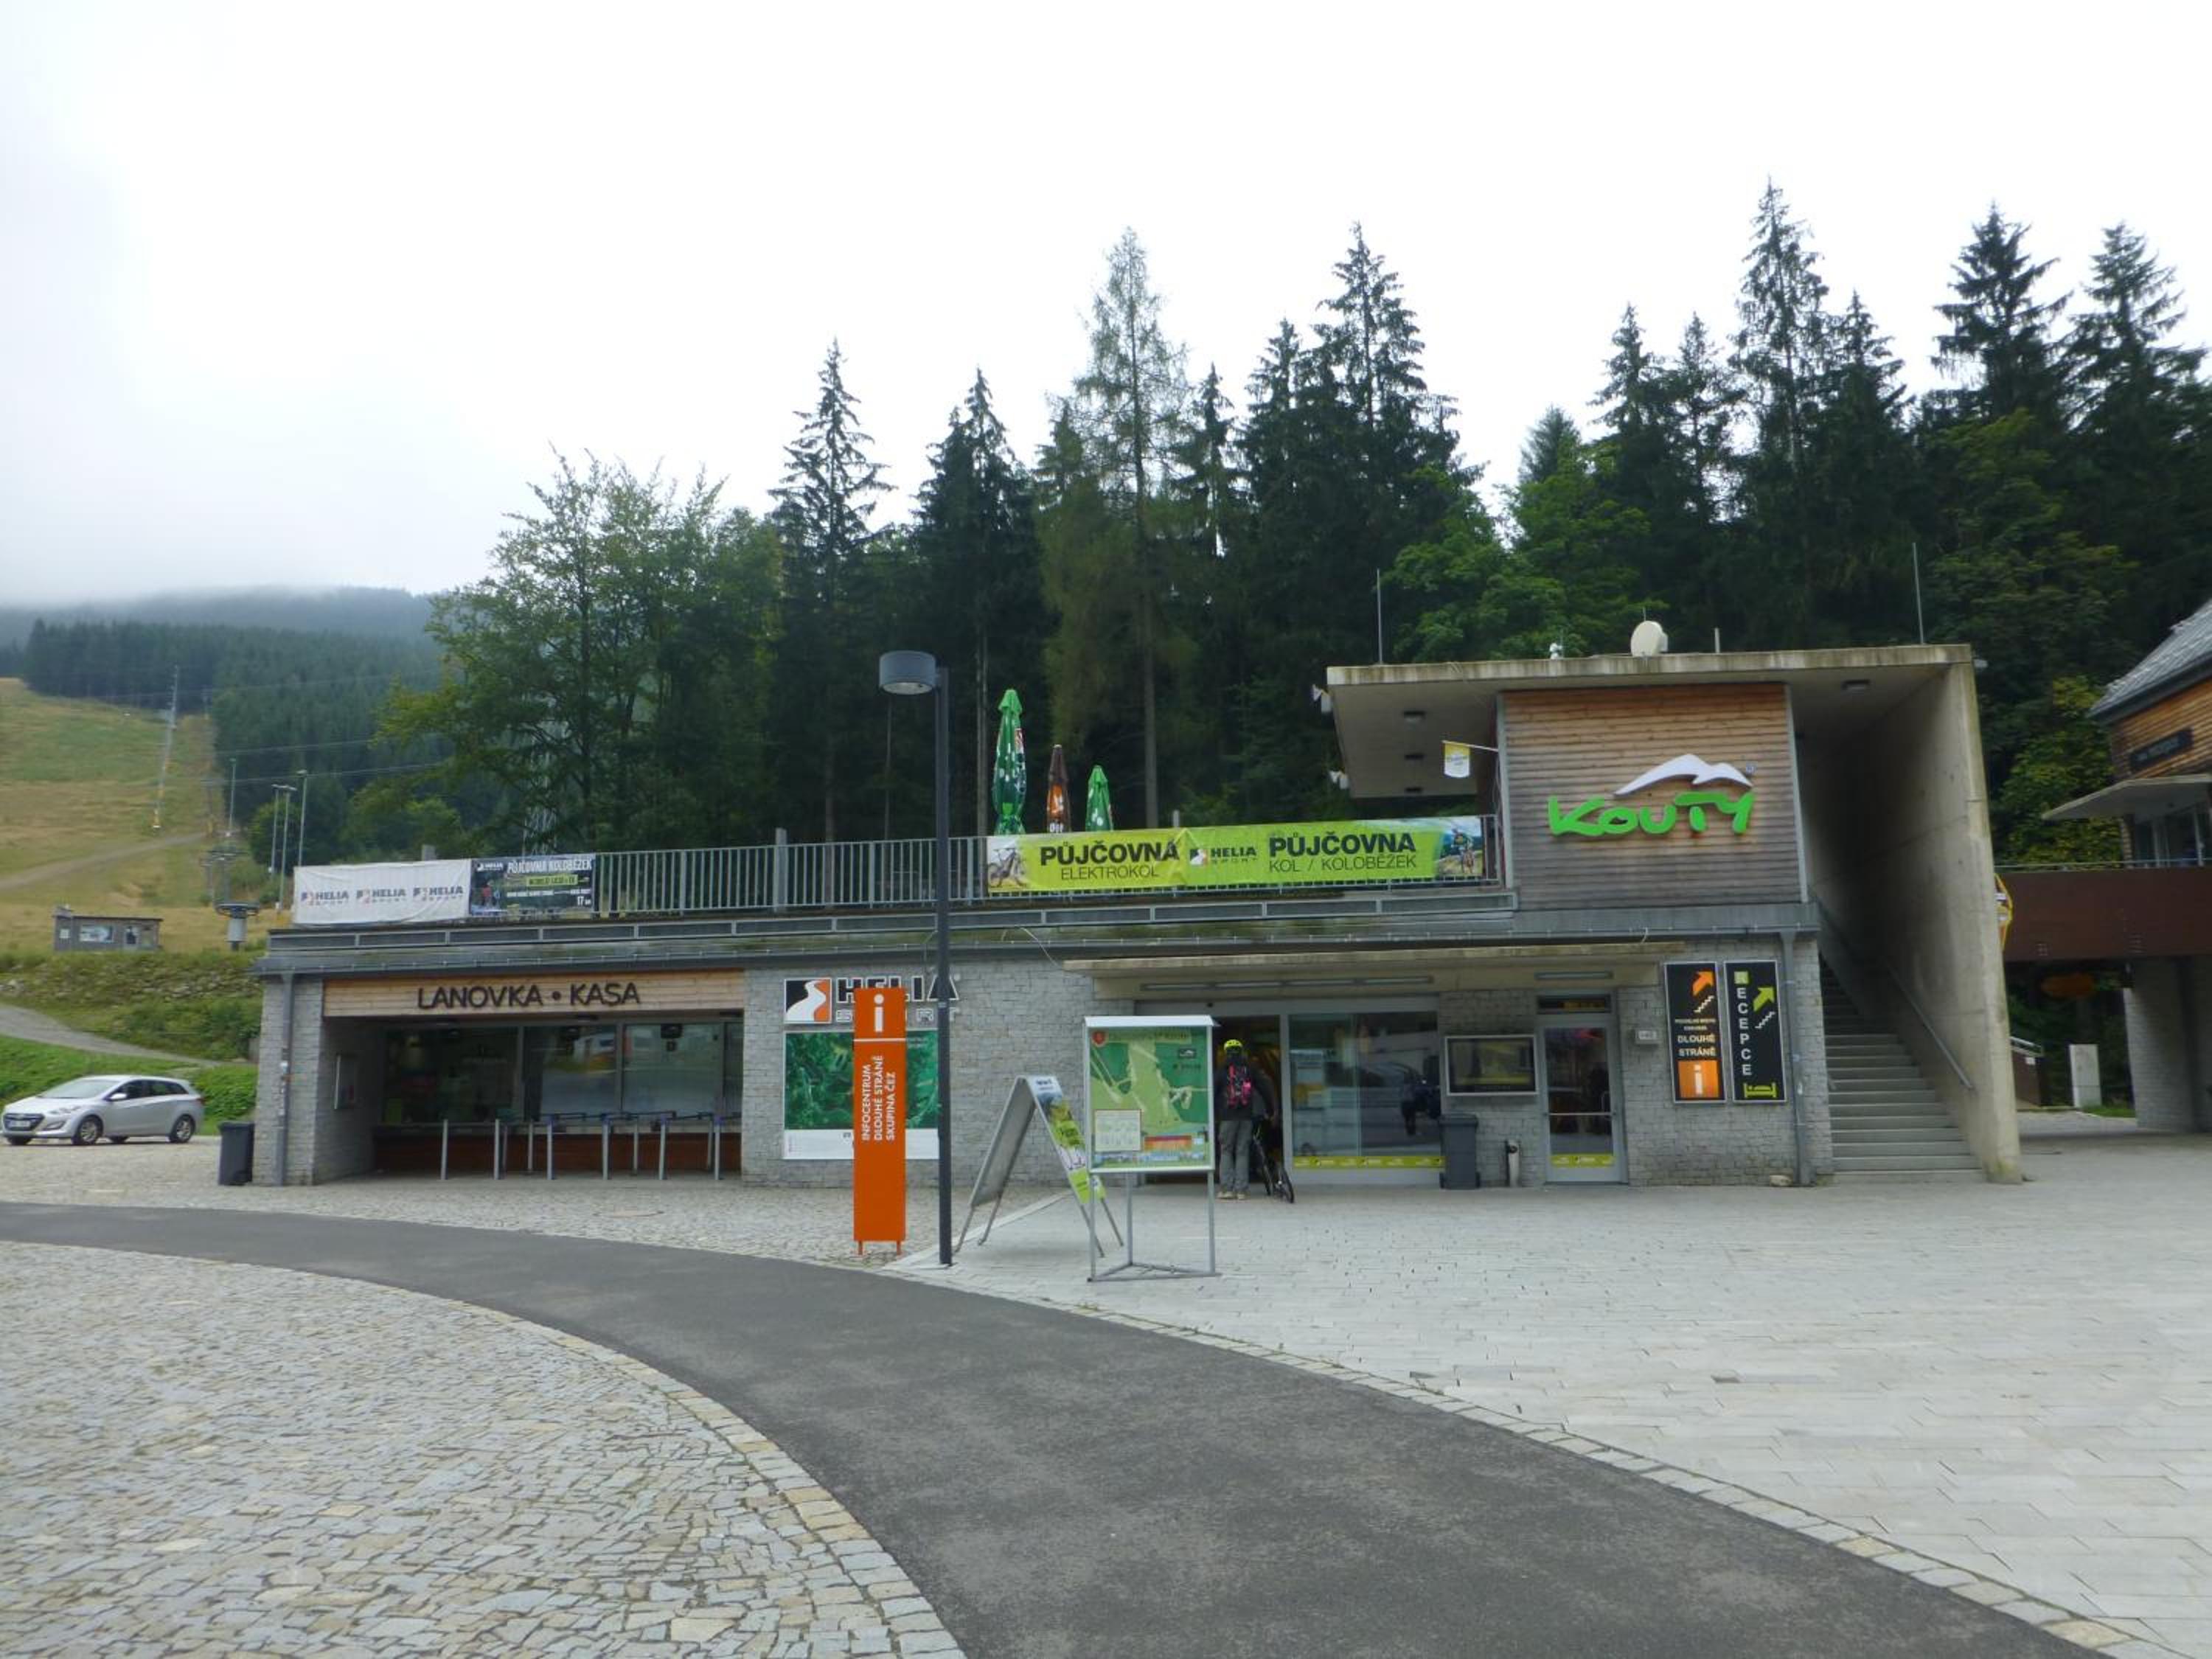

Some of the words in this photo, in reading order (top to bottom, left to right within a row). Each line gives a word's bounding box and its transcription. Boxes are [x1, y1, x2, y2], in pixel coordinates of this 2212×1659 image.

[1211, 847, 1257, 858] HELIA
[1269, 832, 1416, 858] PŮJČOVNA
[1061, 864, 1160, 881] ELEKTROKOL
[1269, 859, 1300, 873] KOL
[316, 891, 349, 900] HELIA
[372, 888, 406, 897] HELIA
[429, 886, 464, 896] HELIA
[417, 984, 543, 1009] LANOVKA
[570, 982, 640, 1006] KASA
[861, 1064, 872, 1141] INFOCENTRUM
[886, 1093, 895, 1141] SKUPINA
